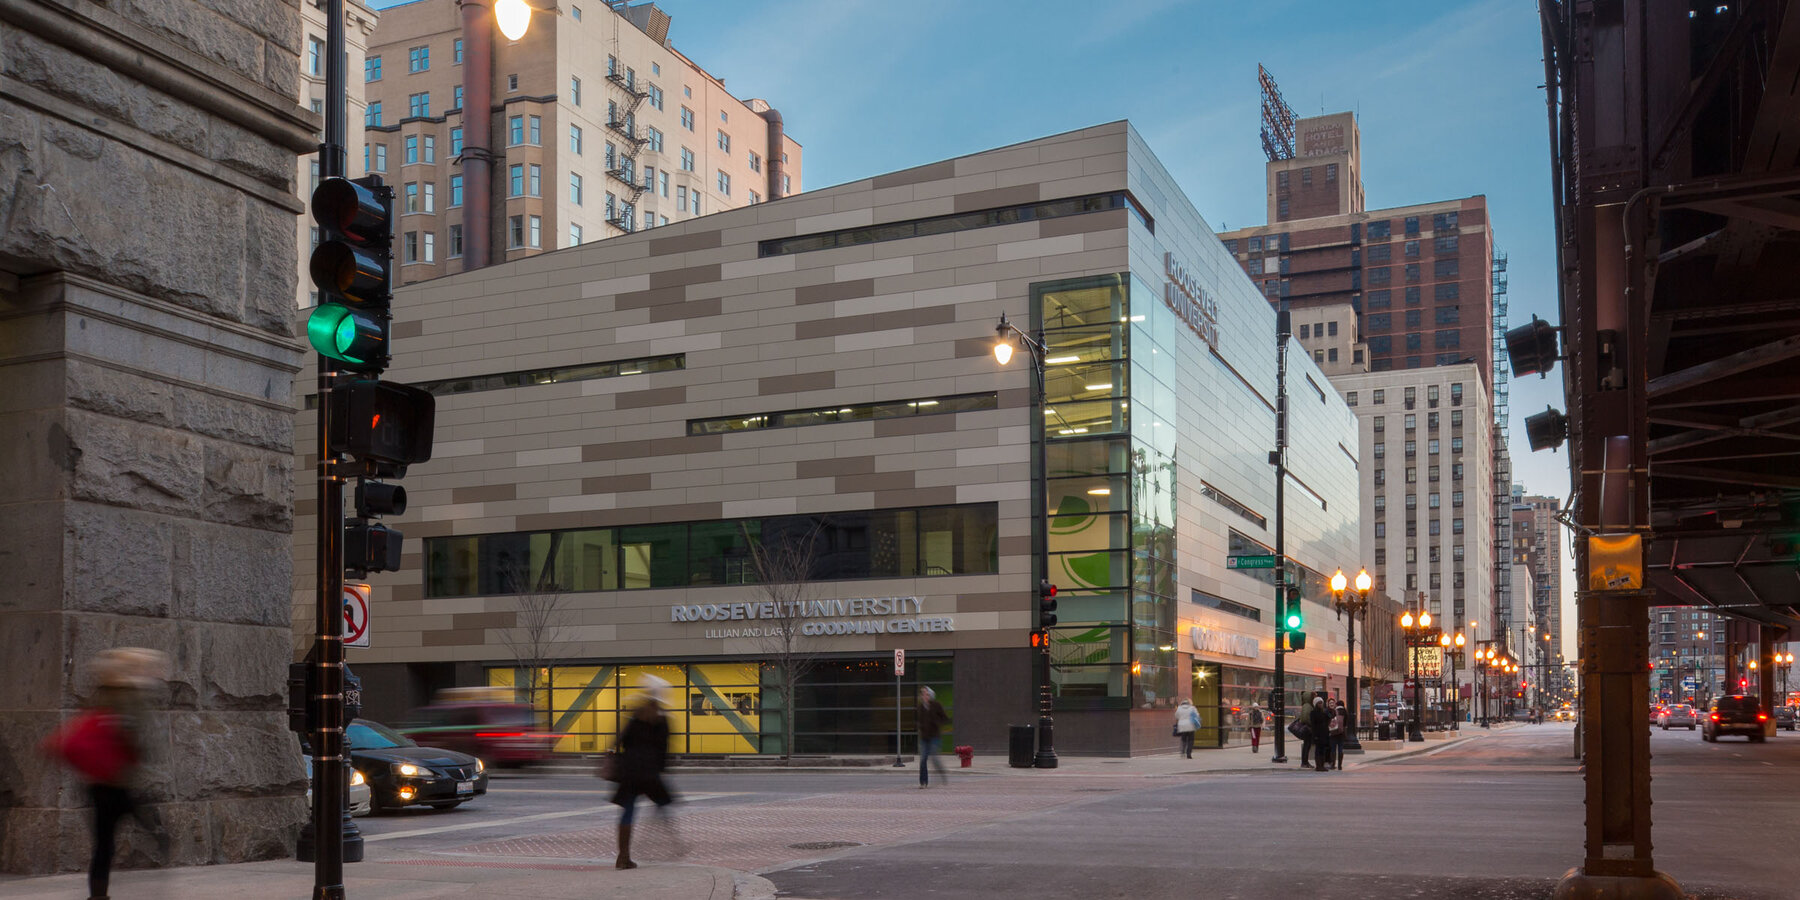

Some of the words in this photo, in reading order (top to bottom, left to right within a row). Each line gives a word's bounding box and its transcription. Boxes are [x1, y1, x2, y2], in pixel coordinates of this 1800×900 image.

[1305, 130, 1343, 142] HOTEL
[1164, 251, 1219, 324] ROOSEVELT
[1164, 282, 1219, 350] UNIVERSITY
[1241, 558, 1264, 567] Congress
[671, 600, 801, 622] ROOSEVELT
[800, 596, 926, 617] UNIVERSITY
[705, 628, 741, 639] LILLIAN
[742, 628, 761, 637] AND
[764, 626, 796, 637] LARY
[802, 619, 885, 636] GOODMAN
[886, 617, 955, 634] CENTER
